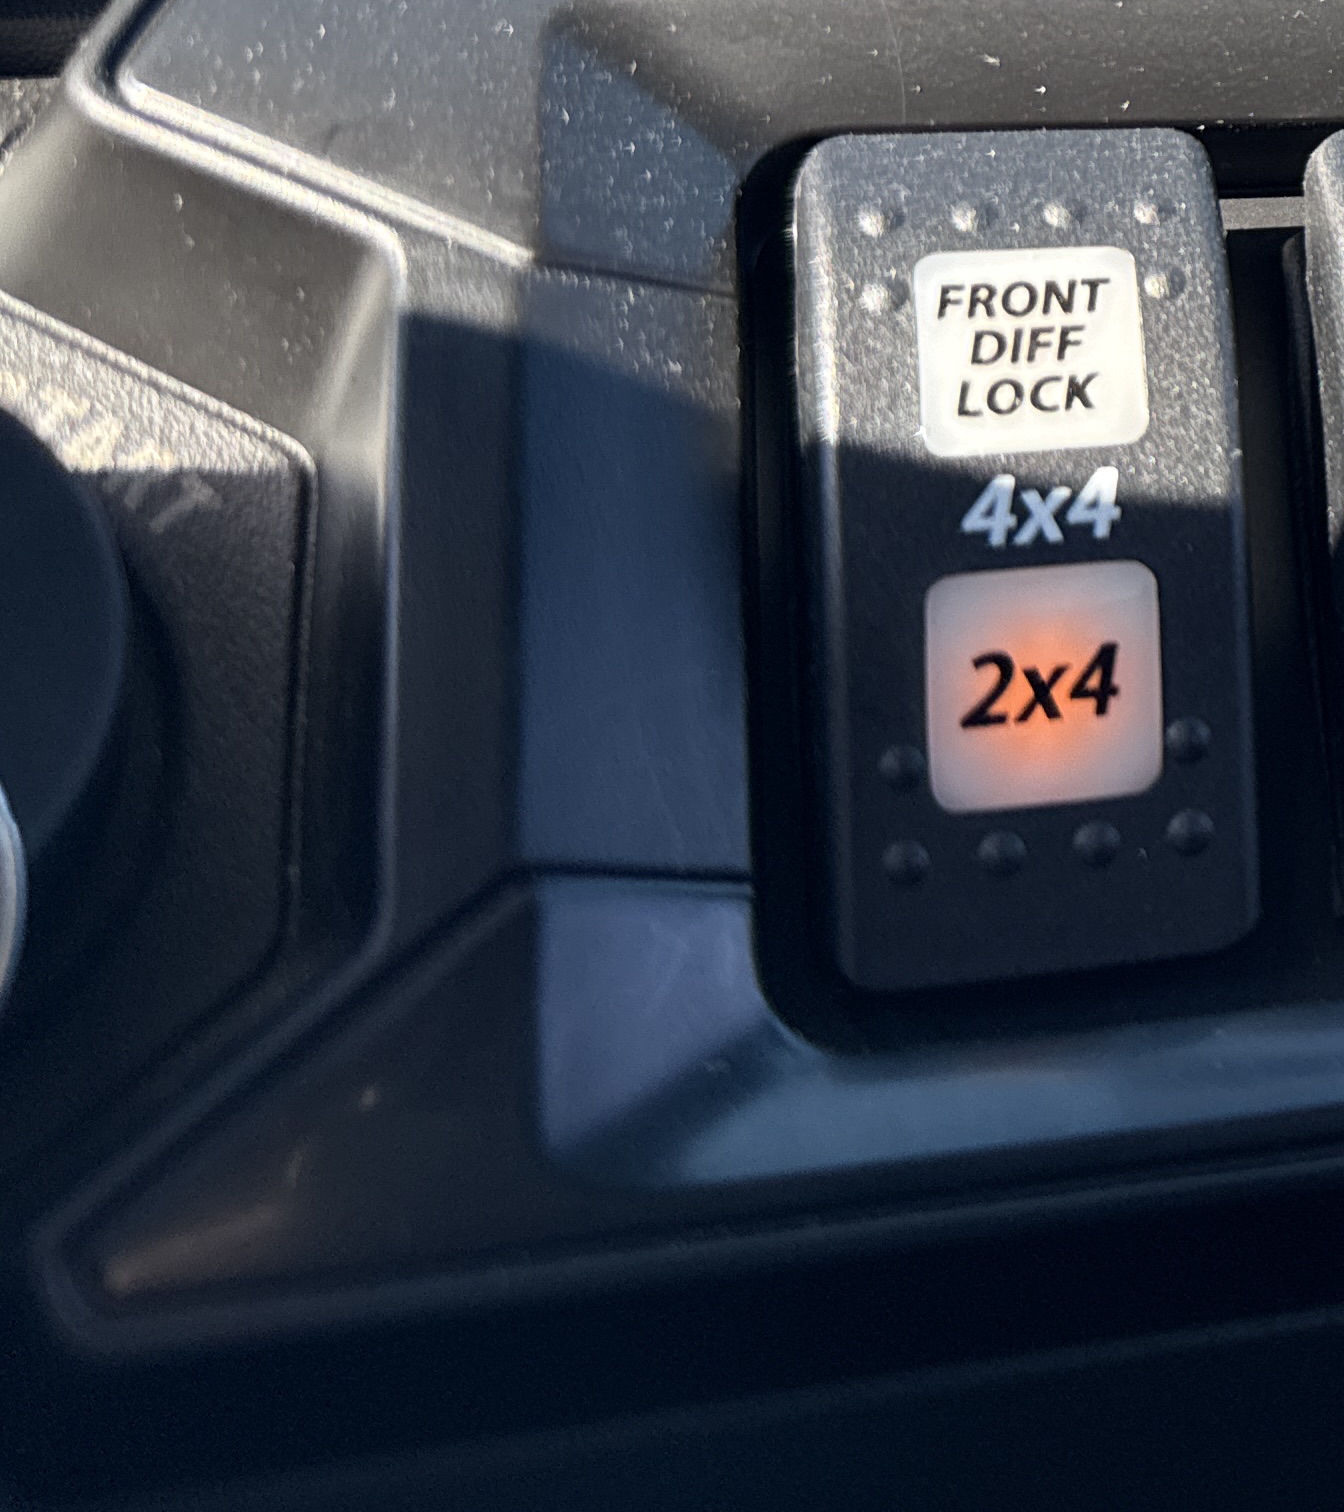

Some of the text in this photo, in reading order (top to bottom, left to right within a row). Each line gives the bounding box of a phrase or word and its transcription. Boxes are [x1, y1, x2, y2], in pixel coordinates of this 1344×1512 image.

[937, 278, 1111, 318] FRONT
[970, 326, 1085, 366] DIFF
[957, 372, 1098, 416] LOCK
[962, 466, 1121, 547] 4x4
[960, 642, 1120, 729] 2x4
